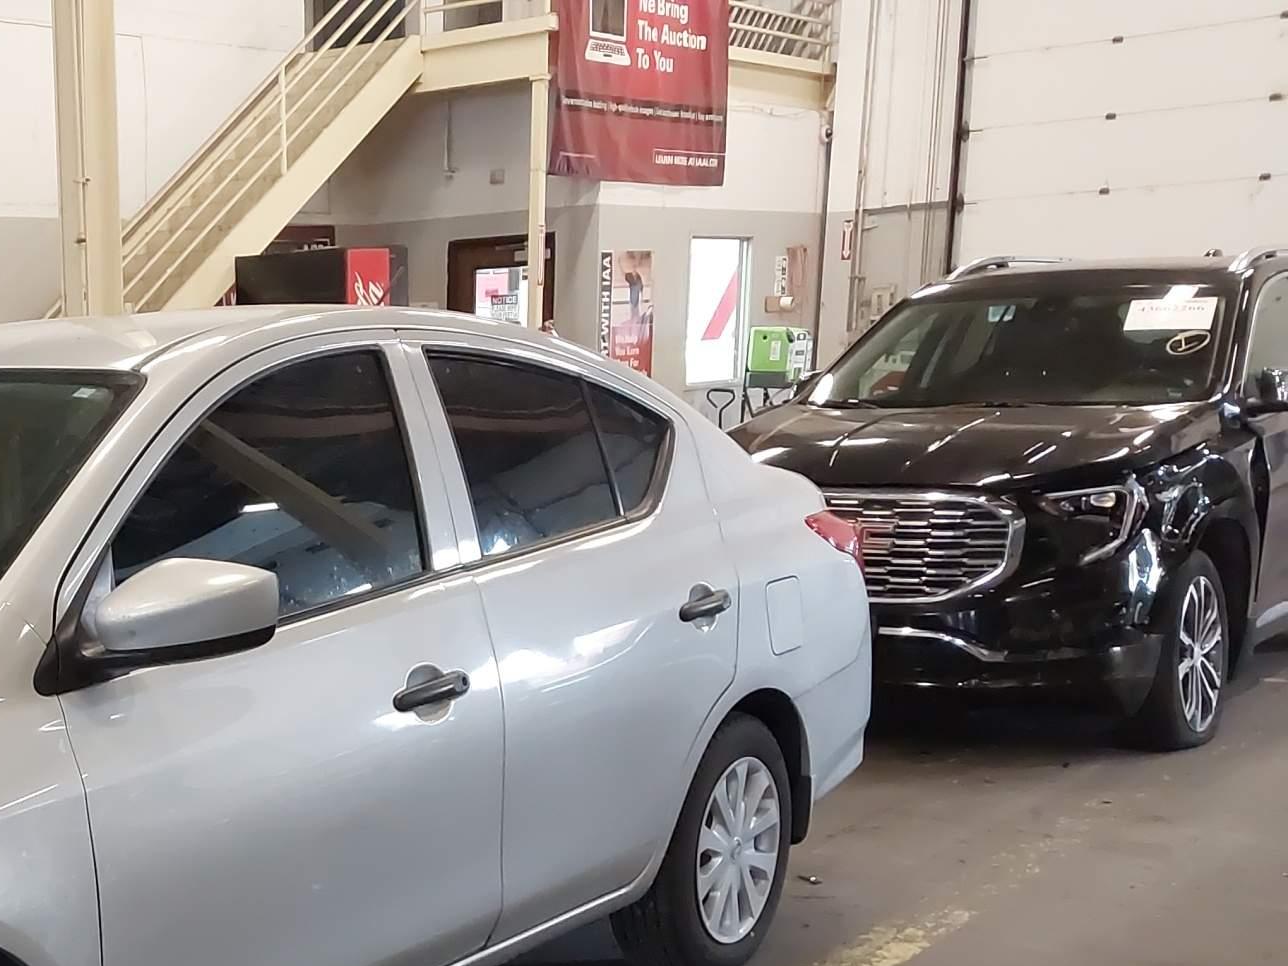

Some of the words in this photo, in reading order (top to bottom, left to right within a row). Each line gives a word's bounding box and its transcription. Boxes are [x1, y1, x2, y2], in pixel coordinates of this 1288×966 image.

[657, 0, 689, 25] Bring
[637, 19, 659, 42] The
[660, 23, 707, 50] Auction
[636, 47, 650, 70] To
[653, 49, 674, 73] You
[601, 256, 612, 286] IAA
[492, 295, 517, 304] NOTICE
[600, 291, 611, 336] WITH
